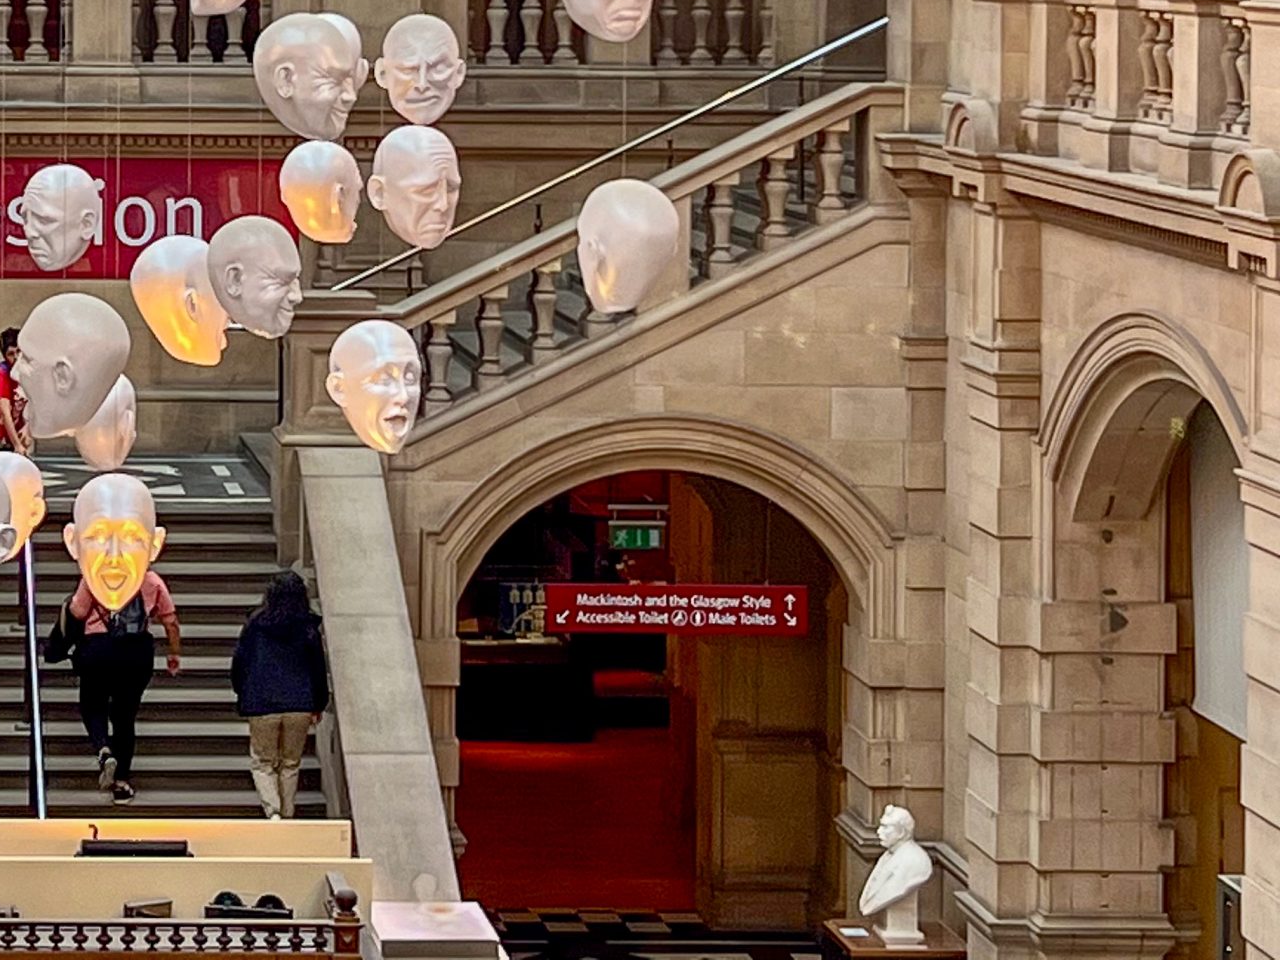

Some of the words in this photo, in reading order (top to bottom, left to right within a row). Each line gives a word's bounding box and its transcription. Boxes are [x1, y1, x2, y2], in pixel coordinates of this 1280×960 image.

[576, 593, 643, 607] Mackintosh
[644, 594, 667, 607] and
[669, 594, 689, 608] the
[690, 594, 740, 610] Glasgow
[742, 594, 772, 610] Style
[575, 610, 637, 624] Accessible
[638, 611, 669, 625] Toilet
[708, 611, 737, 626] Male
[739, 611, 777, 626] Toilets
